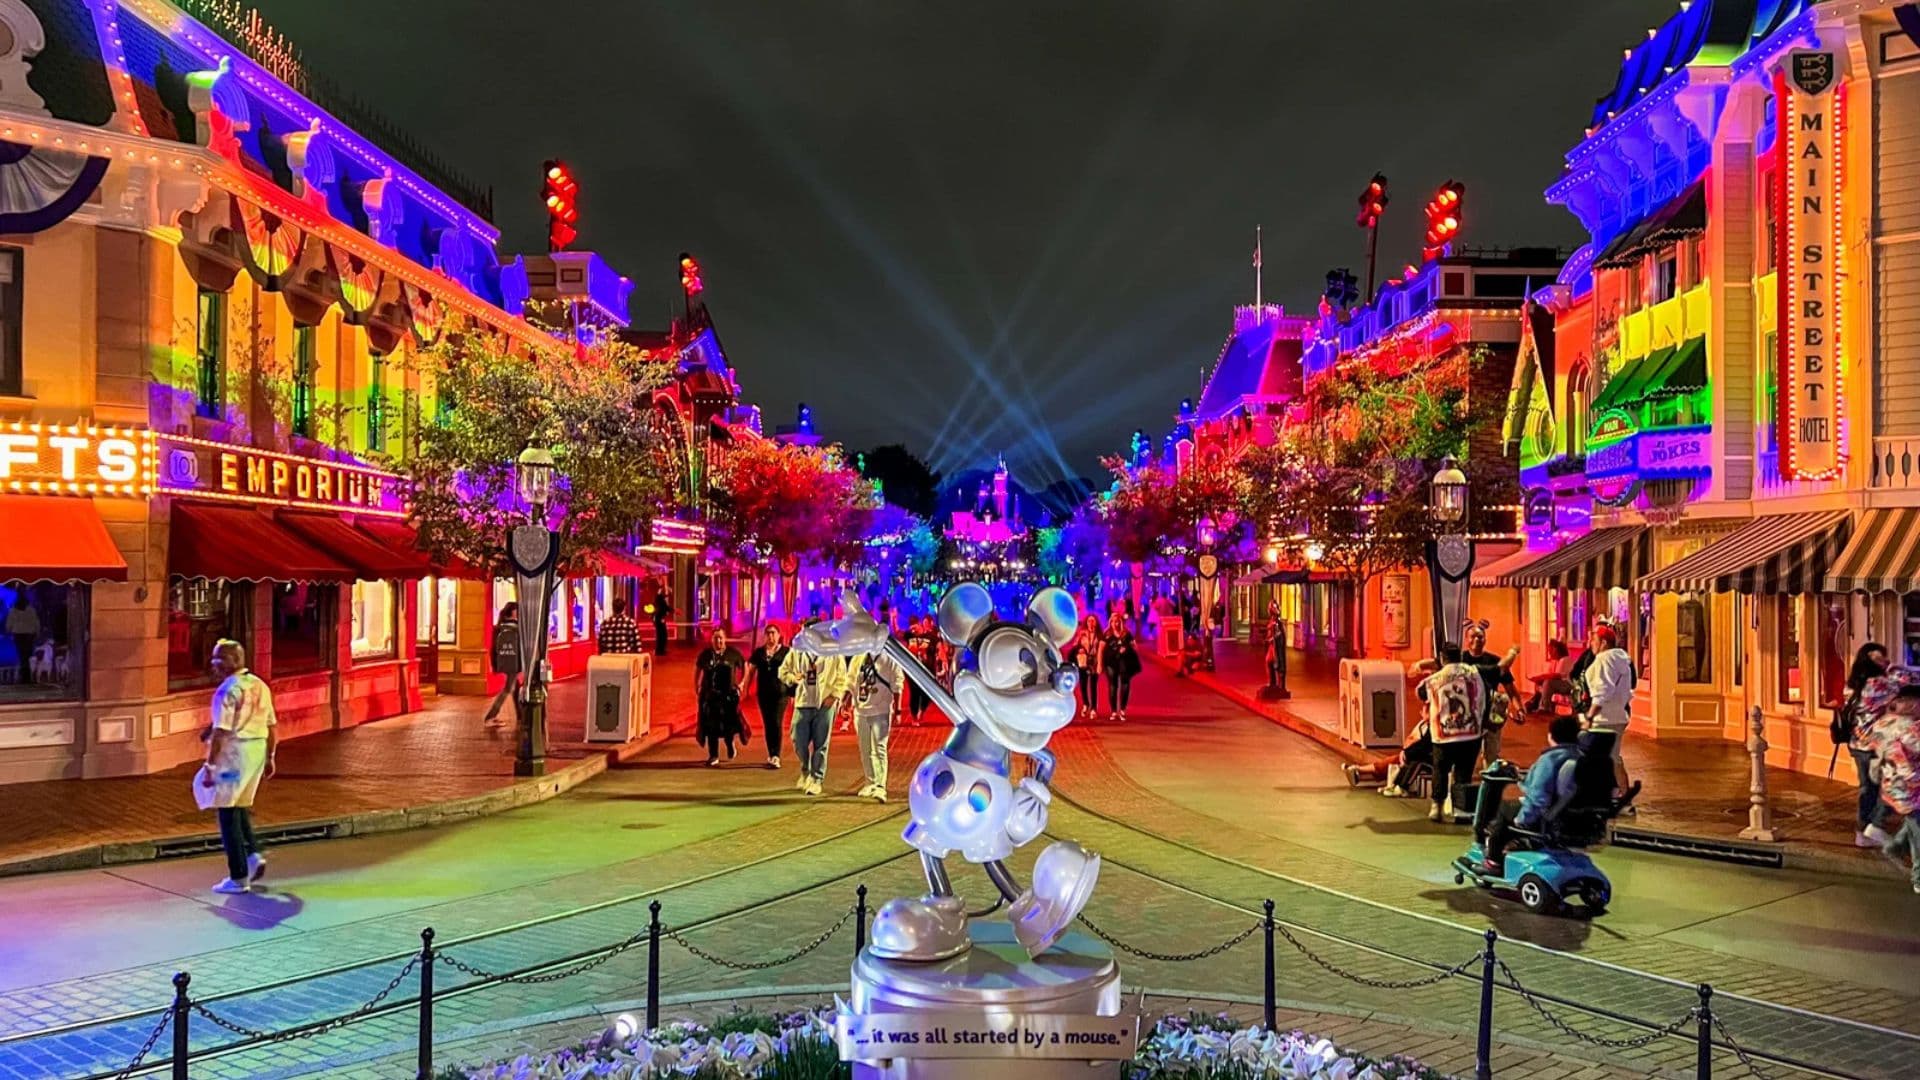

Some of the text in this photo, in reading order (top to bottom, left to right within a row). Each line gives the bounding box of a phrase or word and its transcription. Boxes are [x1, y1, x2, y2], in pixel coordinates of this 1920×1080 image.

[1800, 112, 1823, 214] MAIN
[1802, 244, 1824, 401] STREET
[1799, 417, 1831, 442] HOTEL
[1649, 440, 1701, 464] JOKES
[221, 452, 383, 507] EMPORIUM
[872, 1028, 884, 1043] it
[888, 1031, 920, 1044] was
[925, 1027, 948, 1044] all
[953, 1028, 1018, 1044] started
[1024, 1028, 1045, 1048] by
[1050, 1031, 1060, 1044] a
